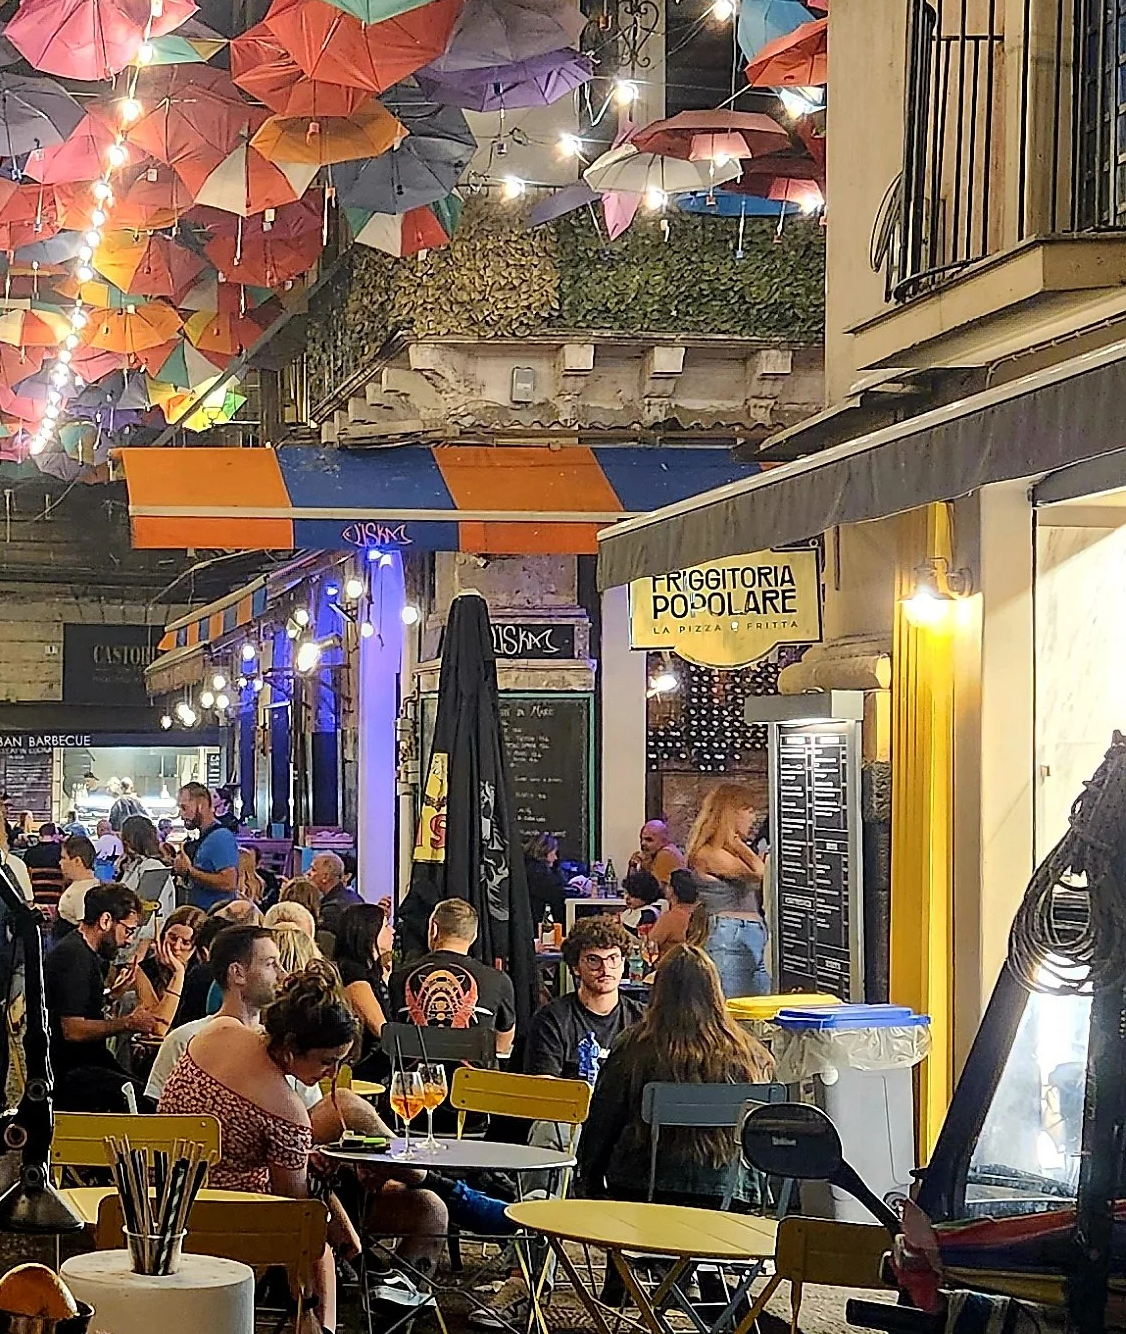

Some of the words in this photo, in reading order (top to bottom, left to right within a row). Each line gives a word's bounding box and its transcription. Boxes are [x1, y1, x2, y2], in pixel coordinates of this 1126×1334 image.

[652, 564, 796, 593] FRIGGITORIA
[652, 588, 798, 620] POPOLARE
[653, 626, 671, 635] LA
[679, 624, 723, 634] PIZZA
[746, 620, 799, 631] FRITTA
[28, 733, 91, 748] BARBECUE
